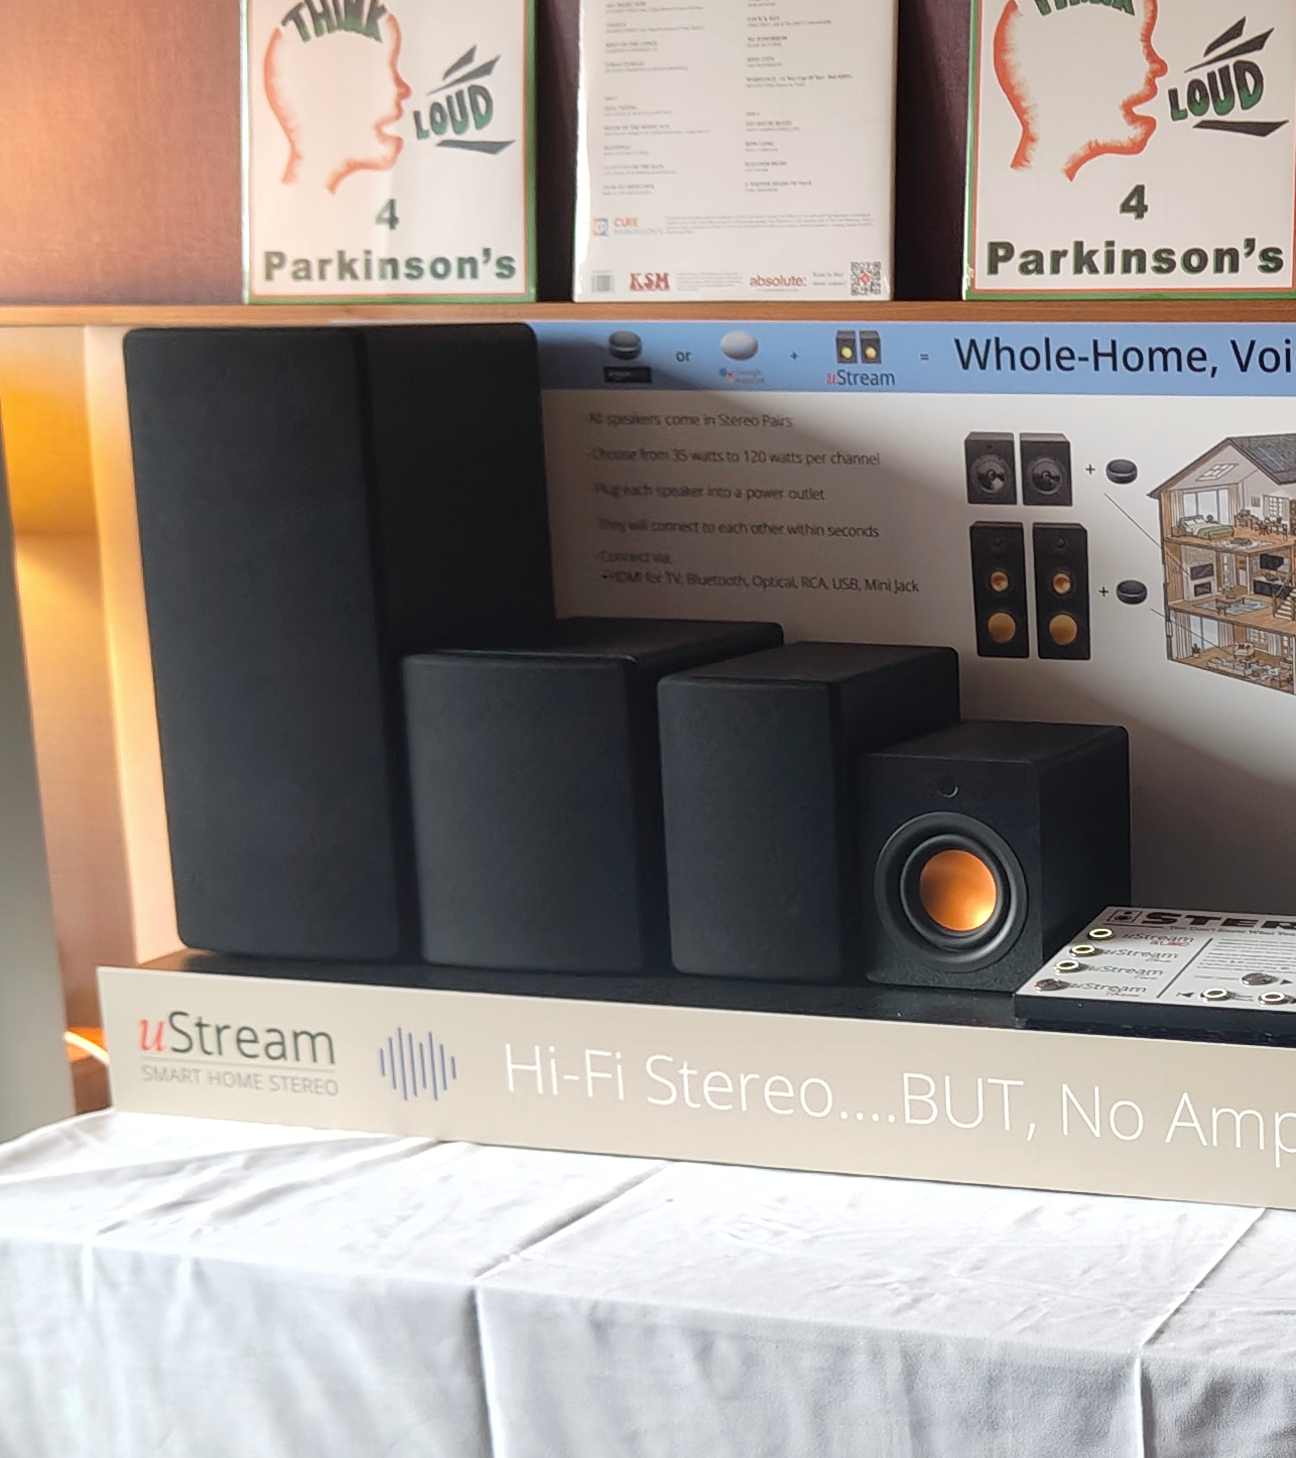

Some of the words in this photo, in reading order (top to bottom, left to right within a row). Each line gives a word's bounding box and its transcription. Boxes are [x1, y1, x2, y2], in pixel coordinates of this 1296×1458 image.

[1168, 59, 1264, 121] LOUD
[413, 84, 494, 140] LOUD
[375, 199, 400, 230] 4
[1119, 184, 1148, 220] 4
[264, 247, 516, 281] Parkinson's
[986, 237, 1284, 276] Parkinson's
[629, 272, 671, 292] KSM
[676, 350, 691, 363] or
[954, 338, 1218, 379] Whole-Home,
[826, 369, 895, 386] uStream
[607, 413, 660, 428] speakers
[664, 415, 700, 426] come
[704, 414, 716, 425] in
[718, 414, 759, 427] Stereo
[762, 415, 793, 428] Pairs
[672, 449, 688, 462] 35
[692, 450, 724, 462] watts
[727, 450, 740, 462] to
[744, 450, 766, 464] 120
[769, 452, 801, 464] watts
[806, 454, 827, 467] per
[830, 452, 880, 466] channel
[707, 485, 732, 498] into
[734, 488, 742, 498] a
[746, 488, 784, 502] power
[788, 487, 825, 501] outlet
[703, 521, 715, 533] to
[718, 521, 748, 534] each
[751, 522, 784, 535] other
[787, 523, 824, 537] within
[827, 524, 880, 538] seconds
[865, 579, 891, 592] Mini
[893, 579, 920, 595] Jack
[138, 1010, 336, 1065] uStream
[142, 1064, 204, 1086] SMART
[207, 1069, 265, 1091] HOME
[269, 1074, 339, 1096] STEREO
[504, 1042, 626, 1101] Hi-Fi
[1060, 1083, 1145, 1142] No
